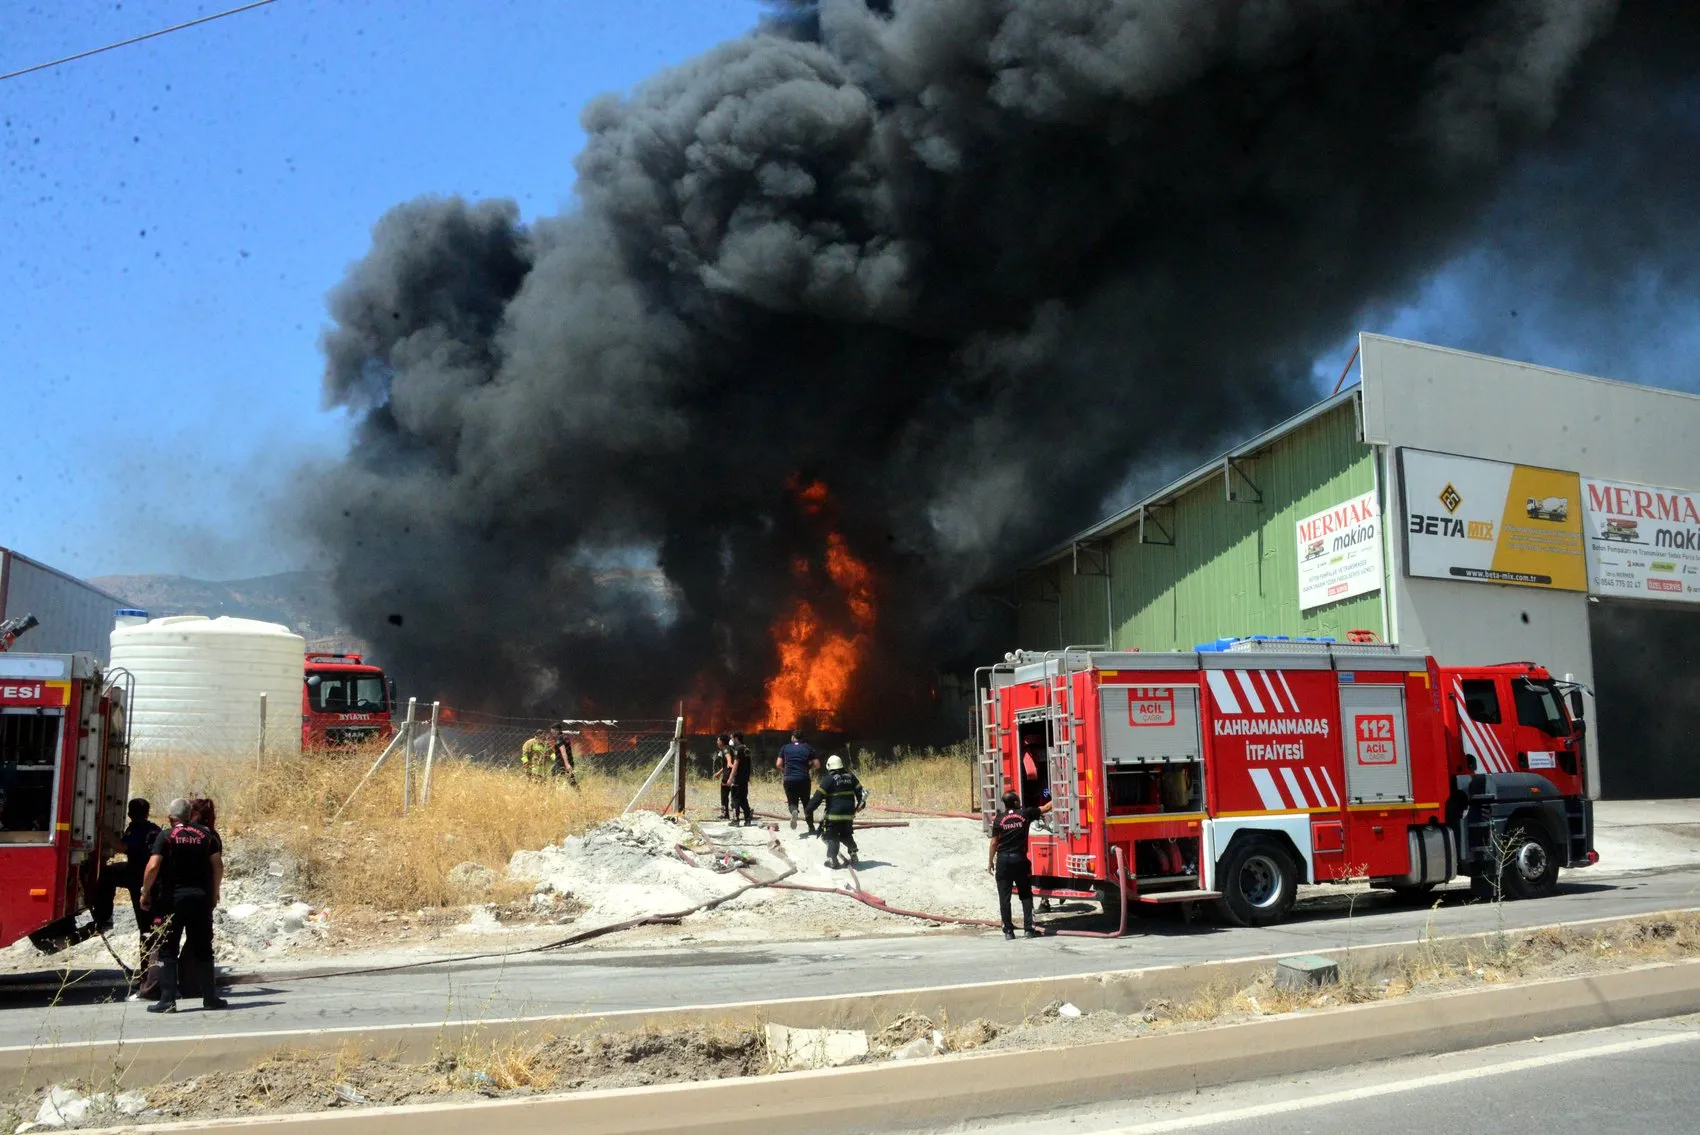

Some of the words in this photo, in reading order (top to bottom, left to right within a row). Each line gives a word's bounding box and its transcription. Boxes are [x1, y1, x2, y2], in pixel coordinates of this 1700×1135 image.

[1587, 484, 1700, 524] MERMA
[1299, 497, 1373, 544] MERMAK
[1410, 514, 1465, 538] BETA
[1468, 522, 1493, 540] MIX
[1333, 525, 1375, 552] makina
[1466, 569, 1537, 582] www.beta-mix.com.tr
[0, 684, 40, 699] ESİ
[1140, 702, 1165, 714] ACİL
[1214, 719, 1328, 738] KAHRAMANMARAŞ
[1360, 719, 1391, 738] 112
[1246, 739, 1304, 760] İTFAİYESİ
[1366, 741, 1387, 753] ACİL
